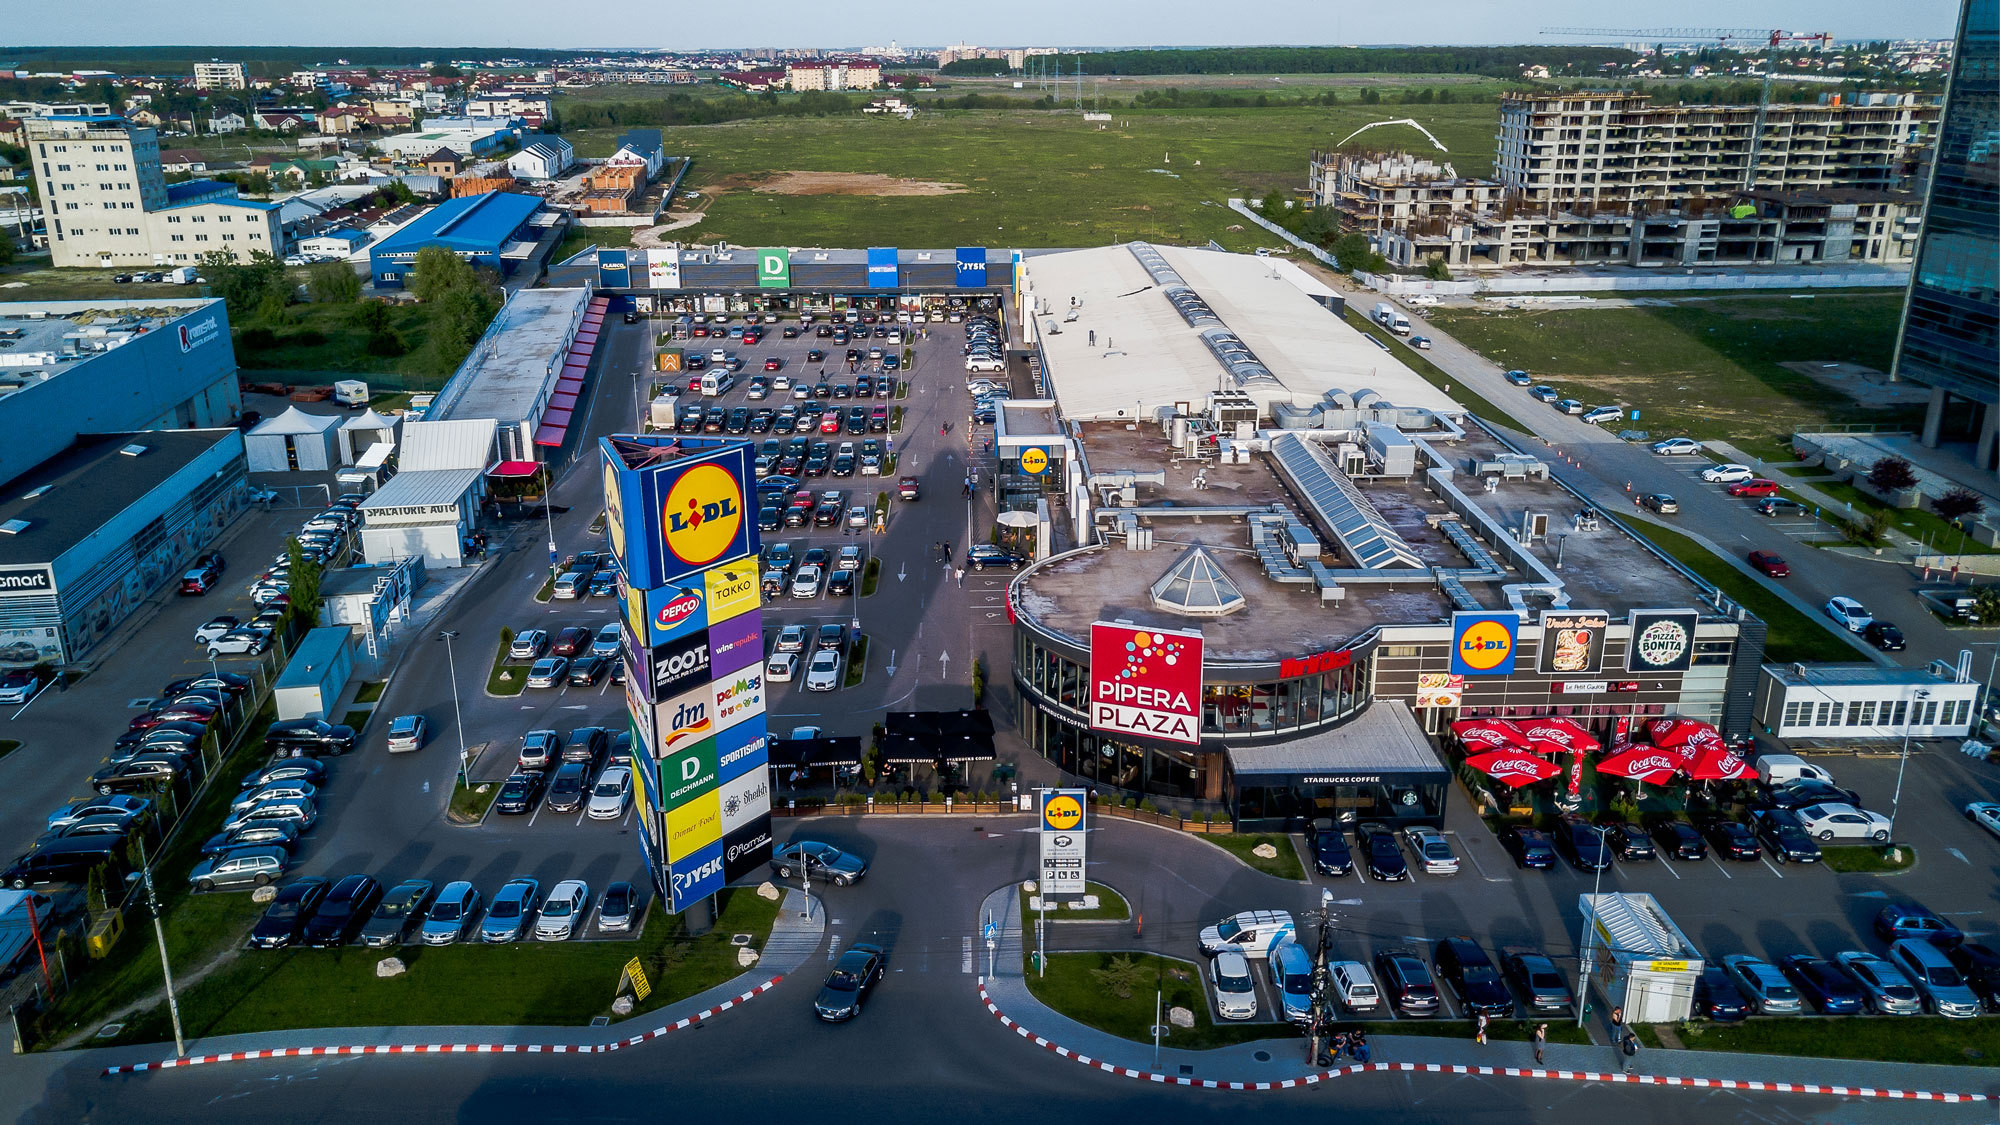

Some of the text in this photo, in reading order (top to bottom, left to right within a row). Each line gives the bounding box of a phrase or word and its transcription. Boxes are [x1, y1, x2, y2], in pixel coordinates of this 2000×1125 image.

[765, 256, 783, 274] D
[963, 262, 985, 270] JYSK
[1023, 456, 1045, 464] LIDL
[669, 498, 737, 533] LIDL
[662, 598, 697, 621] PEPCO
[1463, 636, 1507, 652] LIDL
[1643, 641, 1682, 651] BONITA
[716, 675, 761, 706] petMag
[1099, 675, 1191, 712] PIPERA
[672, 701, 706, 731] dm
[1039, 704, 1088, 730] STARBUCKS COFFEE
[1099, 707, 1190, 737] PLAZA
[720, 737, 765, 767] SPORTISIMO
[1628, 755, 1672, 774] Coca-Cola
[681, 756, 700, 781] D
[1491, 760, 1538, 775] Coca-Cola
[670, 773, 714, 799] DEICHMANN
[743, 782, 768, 805] Sheikh
[1048, 807, 1079, 818] LIDL
[673, 810, 717, 841] Dinner Food
[684, 855, 723, 889] JYSK
